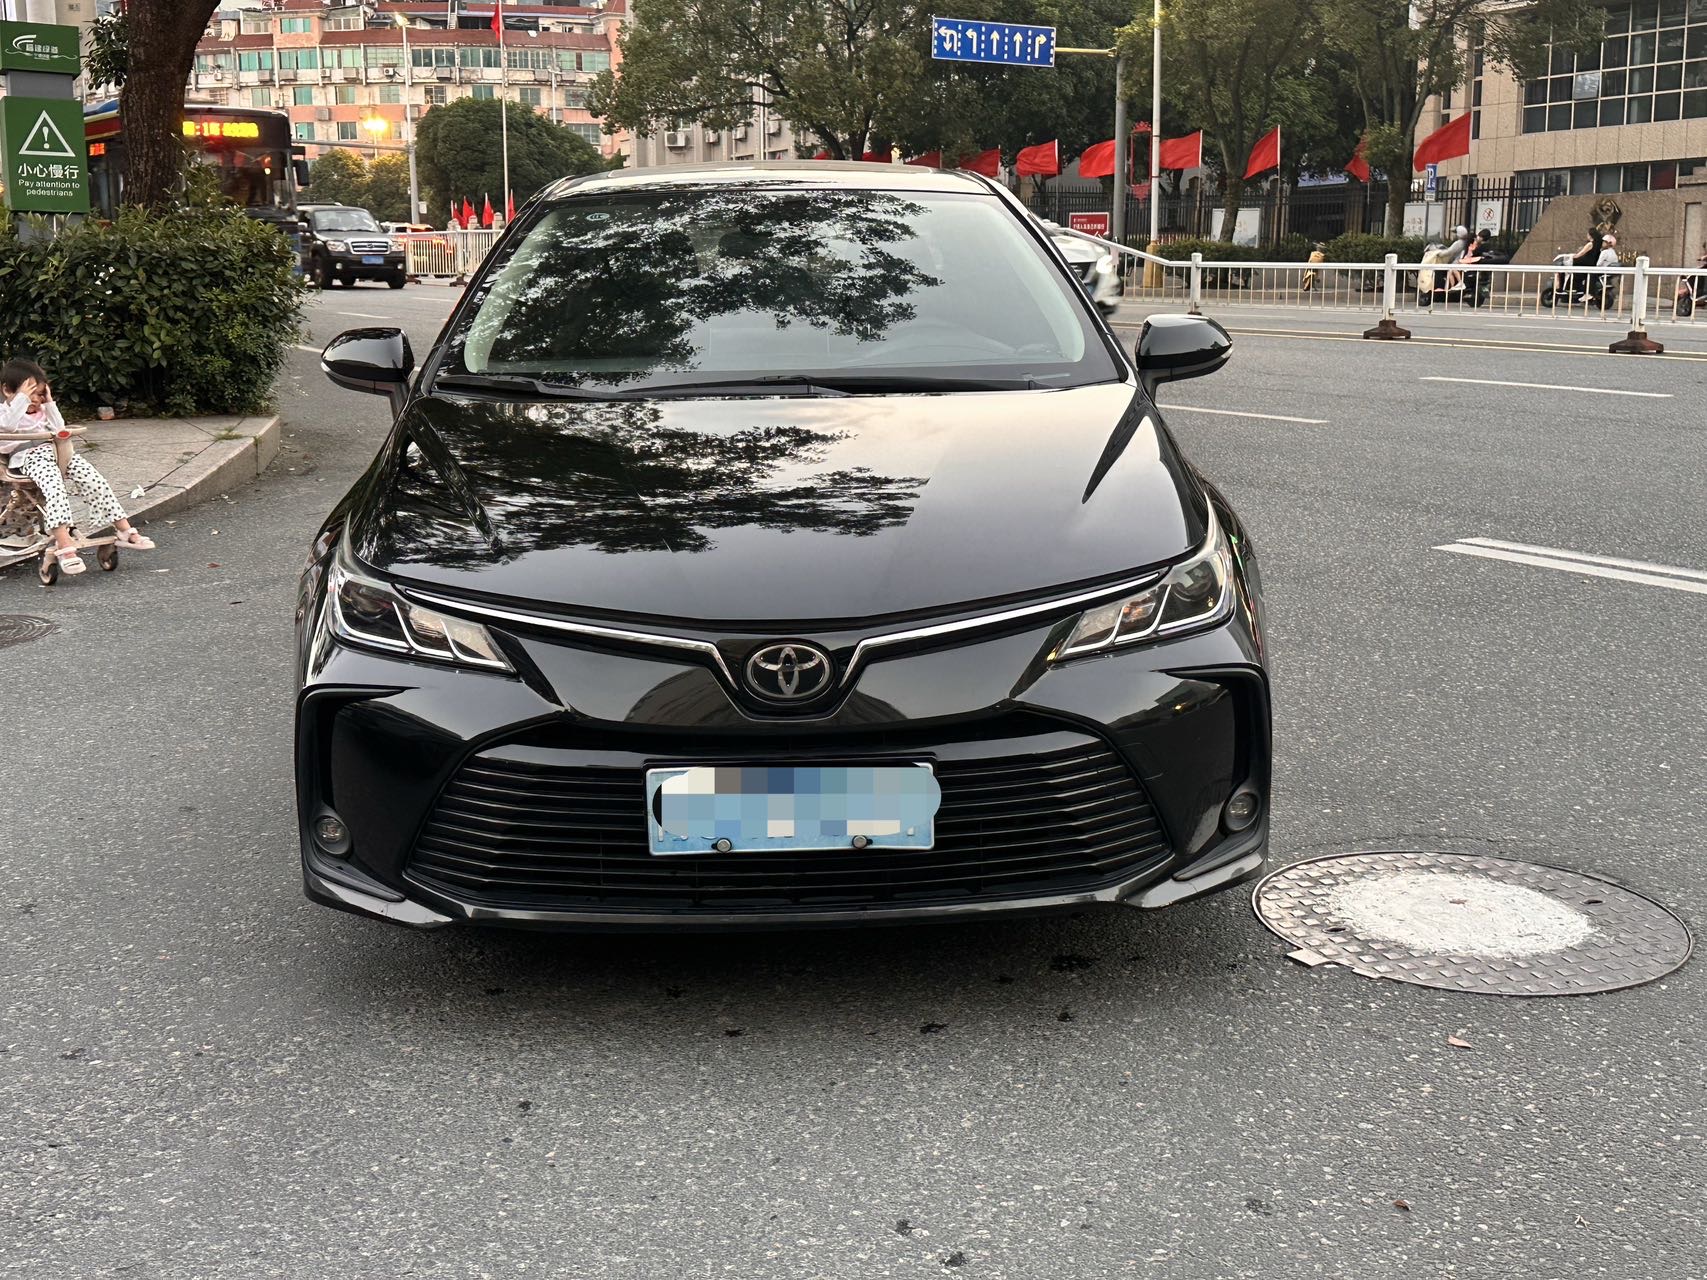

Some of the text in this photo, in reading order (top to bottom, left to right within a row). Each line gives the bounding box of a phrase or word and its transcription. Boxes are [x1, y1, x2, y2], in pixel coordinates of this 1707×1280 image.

[18, 163, 79, 179] 小心慢行
[18, 179, 35, 188] Pay
[35, 180, 71, 188] attention
[1427, 168, 1434, 188] P
[26, 188, 73, 197] pedestrians
